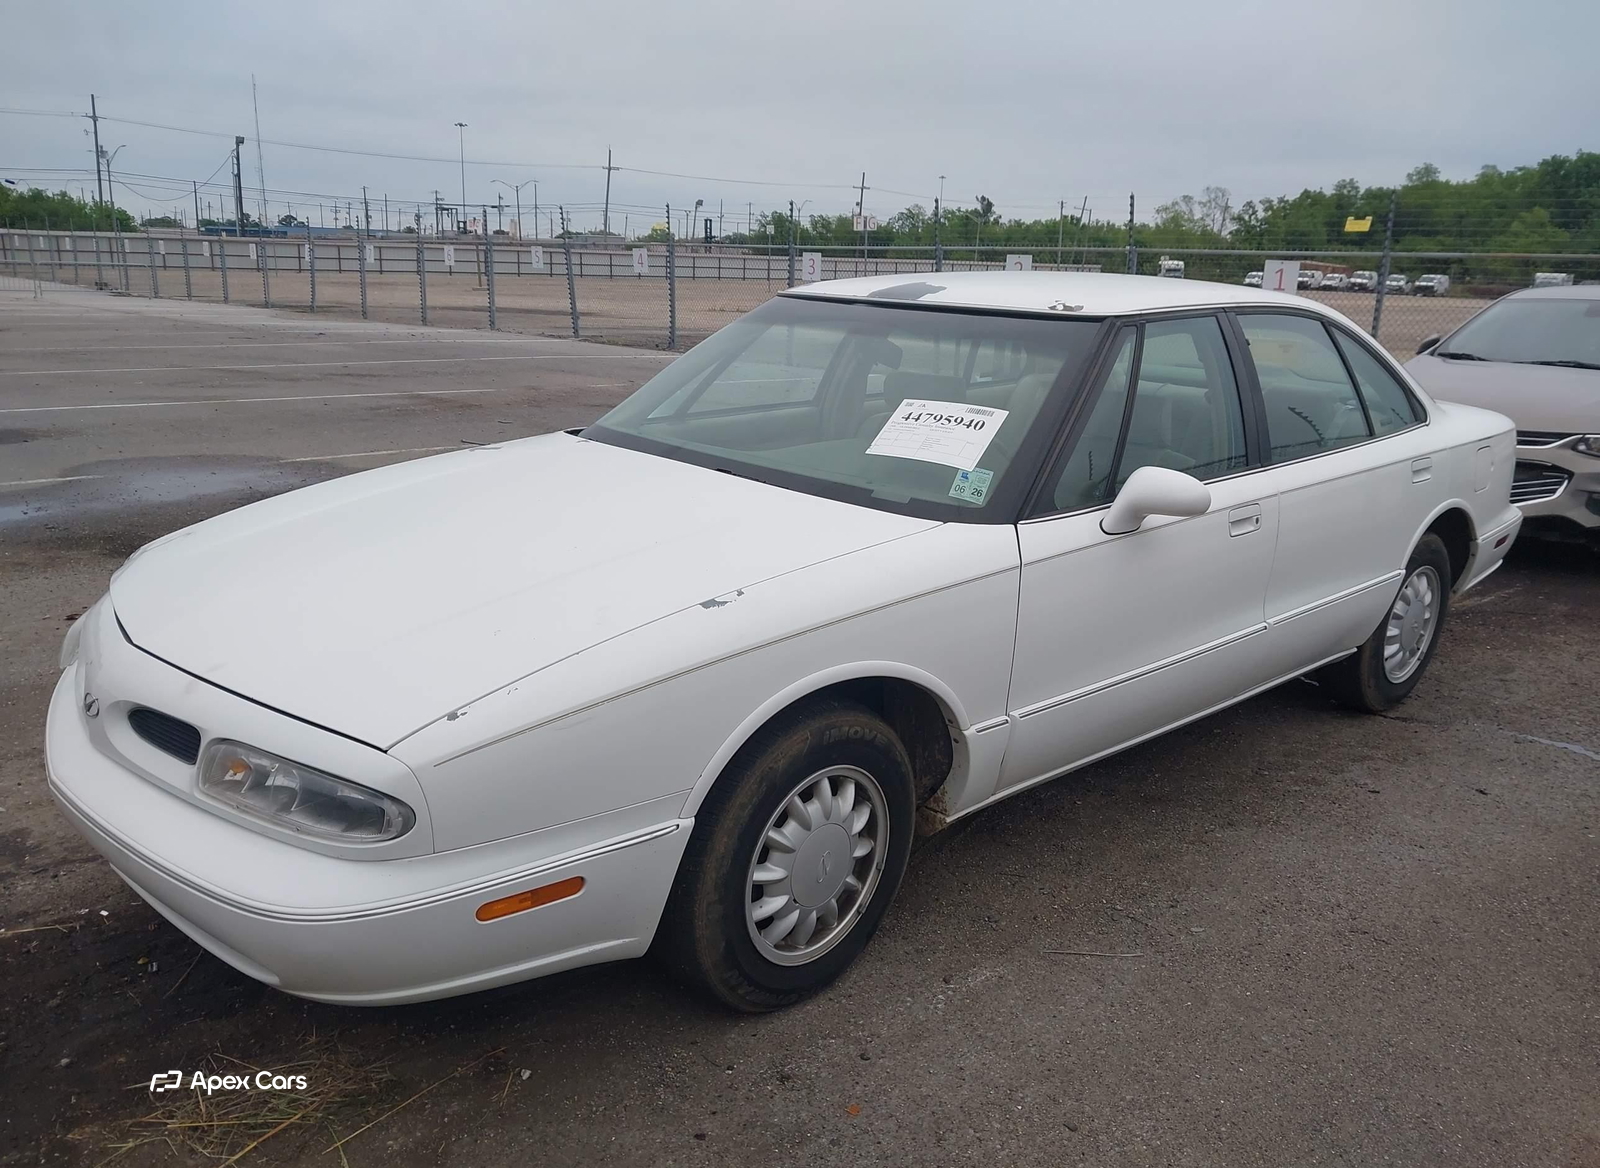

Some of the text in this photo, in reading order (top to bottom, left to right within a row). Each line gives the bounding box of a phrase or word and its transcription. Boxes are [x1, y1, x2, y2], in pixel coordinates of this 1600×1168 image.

[535, 250, 540, 263] 5
[637, 252, 644, 268] 4
[807, 257, 816, 275] 3
[1273, 267, 1285, 291] 1
[901, 411, 986, 431] 44795940
[954, 484, 984, 498] 06 26
